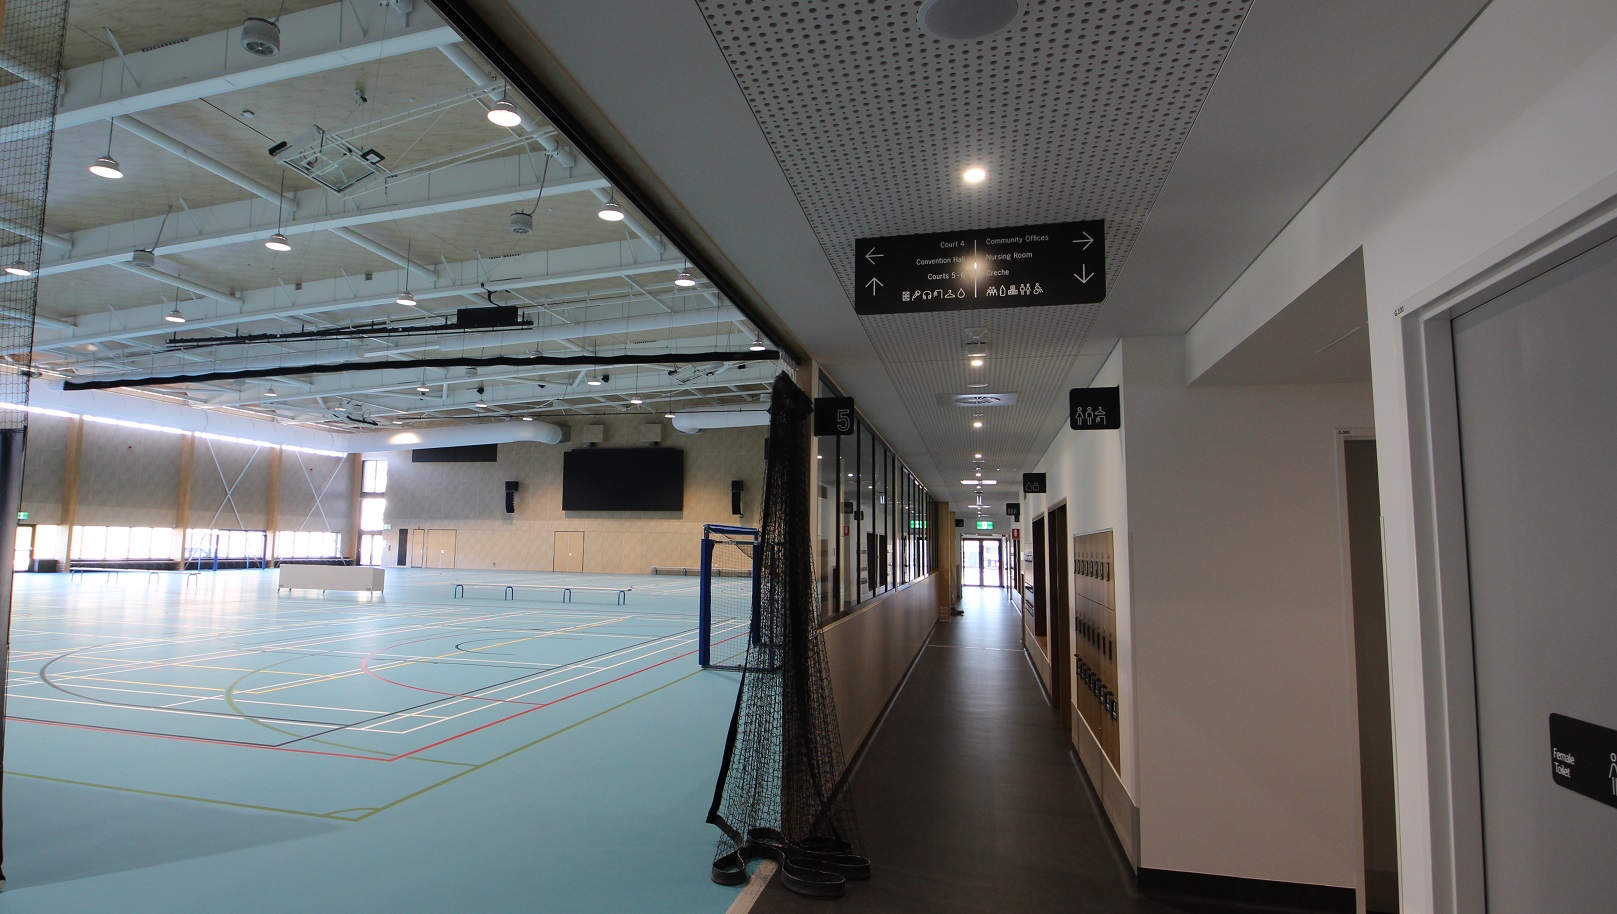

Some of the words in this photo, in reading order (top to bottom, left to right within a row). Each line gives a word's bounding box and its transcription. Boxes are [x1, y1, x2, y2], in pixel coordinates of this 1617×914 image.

[940, 241, 958, 249] Court
[985, 236, 1024, 245] Community
[1025, 234, 1049, 242] Offices
[916, 257, 951, 266] Convention
[953, 255, 966, 263] Hall
[985, 253, 1012, 261] Nursing
[927, 273, 950, 281] Courts
[986, 269, 1010, 277] Creche
[836, 409, 851, 432] 5
[1553, 747, 1575, 765] Female
[1554, 762, 1571, 779] Toilet
